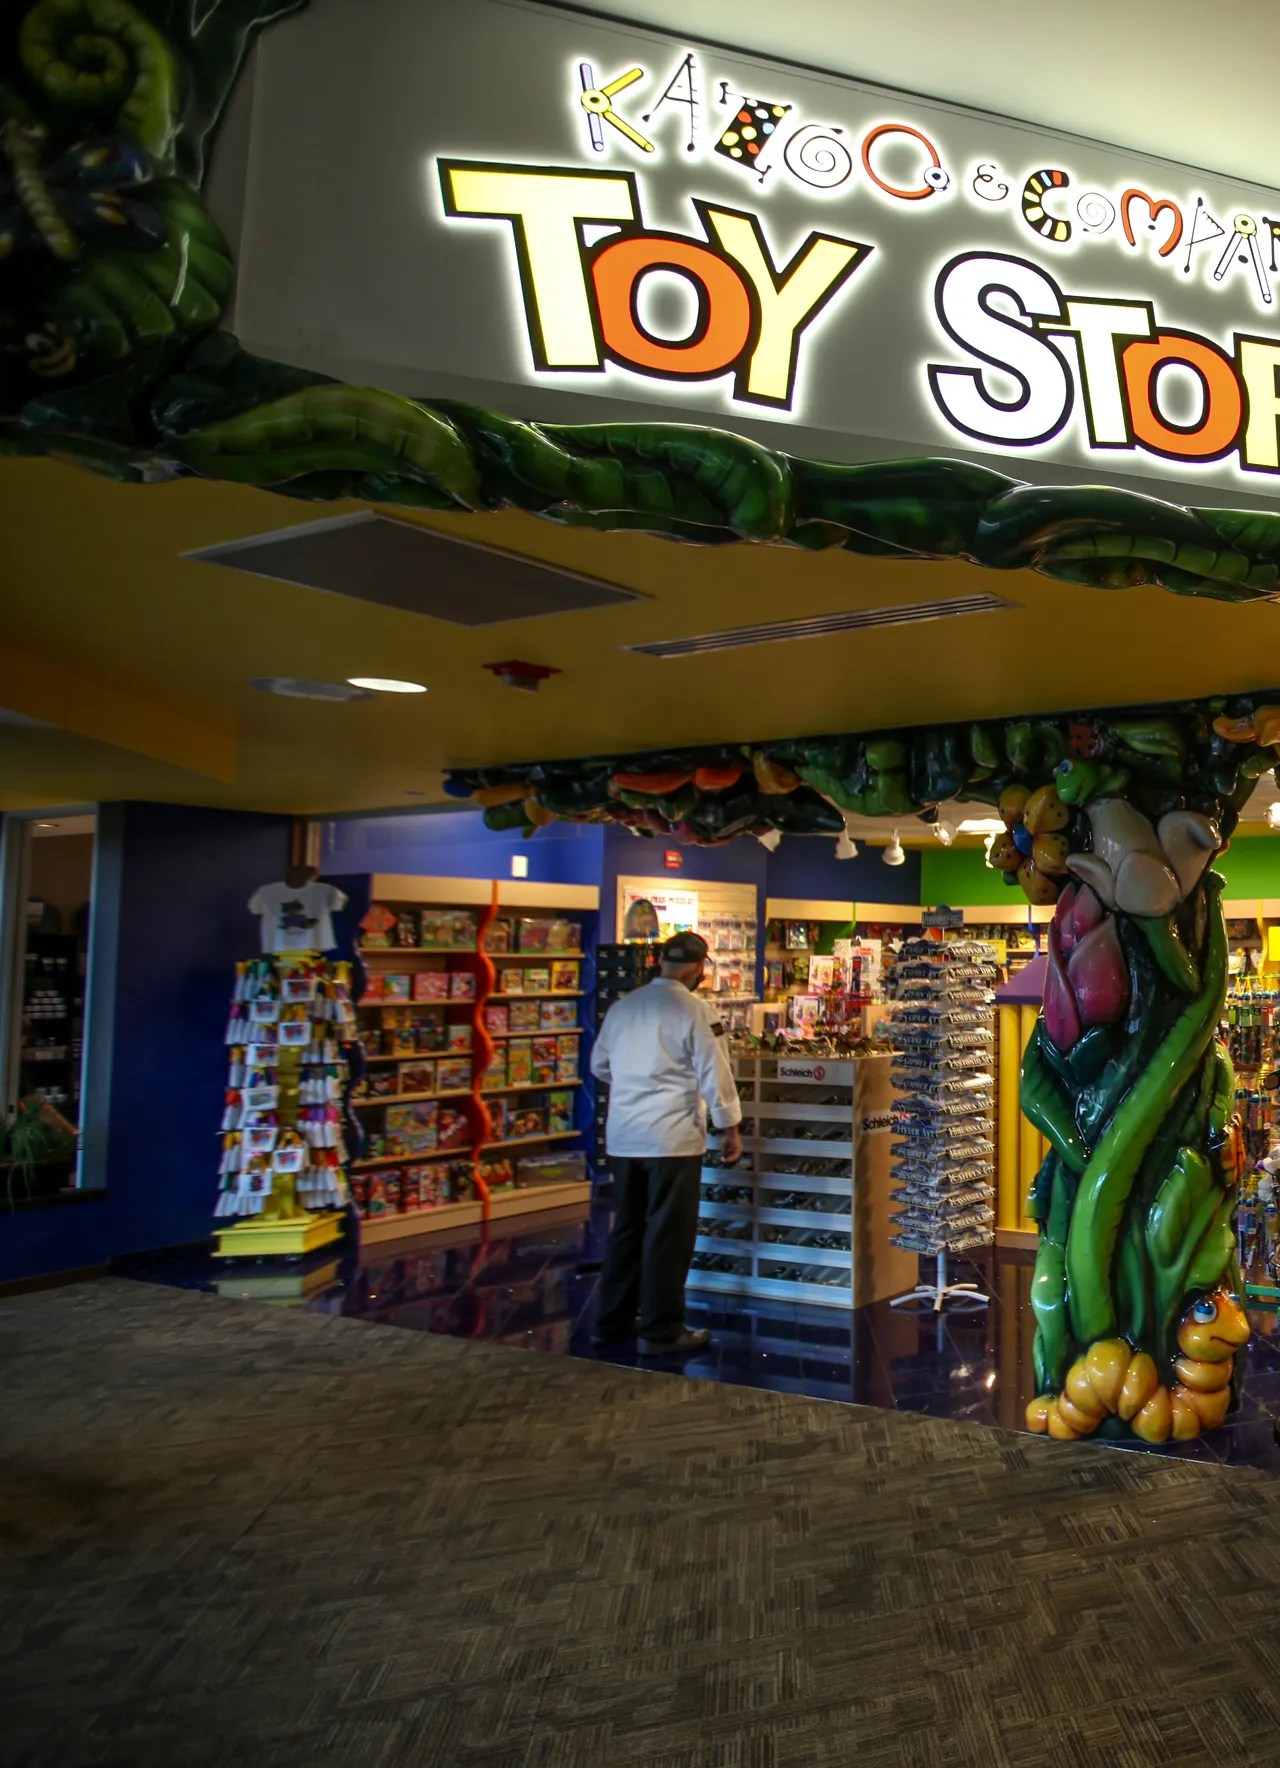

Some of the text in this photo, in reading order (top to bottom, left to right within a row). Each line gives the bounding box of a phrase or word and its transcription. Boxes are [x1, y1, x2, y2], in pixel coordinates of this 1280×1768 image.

[579, 51, 951, 200] KAZOO
[972, 163, 1009, 202] &
[437, 157, 873, 411] TOY
[780, 1066, 813, 1078] Schleich
[863, 1113, 898, 1131] Schleich
